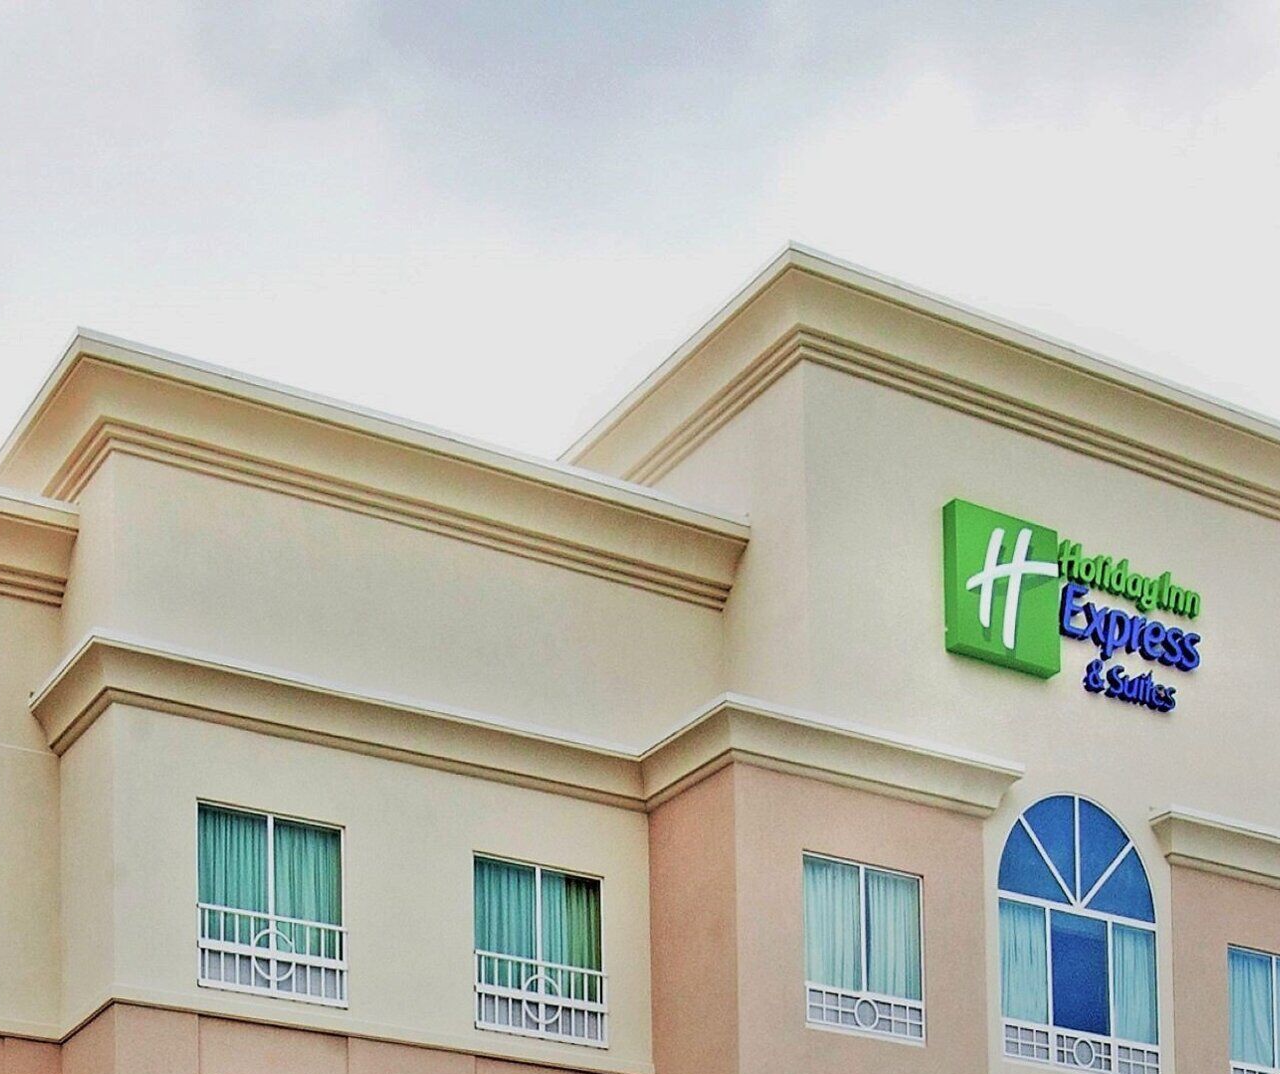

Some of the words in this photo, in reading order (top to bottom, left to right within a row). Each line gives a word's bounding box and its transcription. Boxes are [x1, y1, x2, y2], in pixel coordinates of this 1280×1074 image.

[1058, 539, 1159, 613] Holiday
[1159, 571, 1201, 620] Inn
[1060, 583, 1201, 671] Express
[1083, 659, 1105, 693] &
[1105, 665, 1176, 712] Suites
